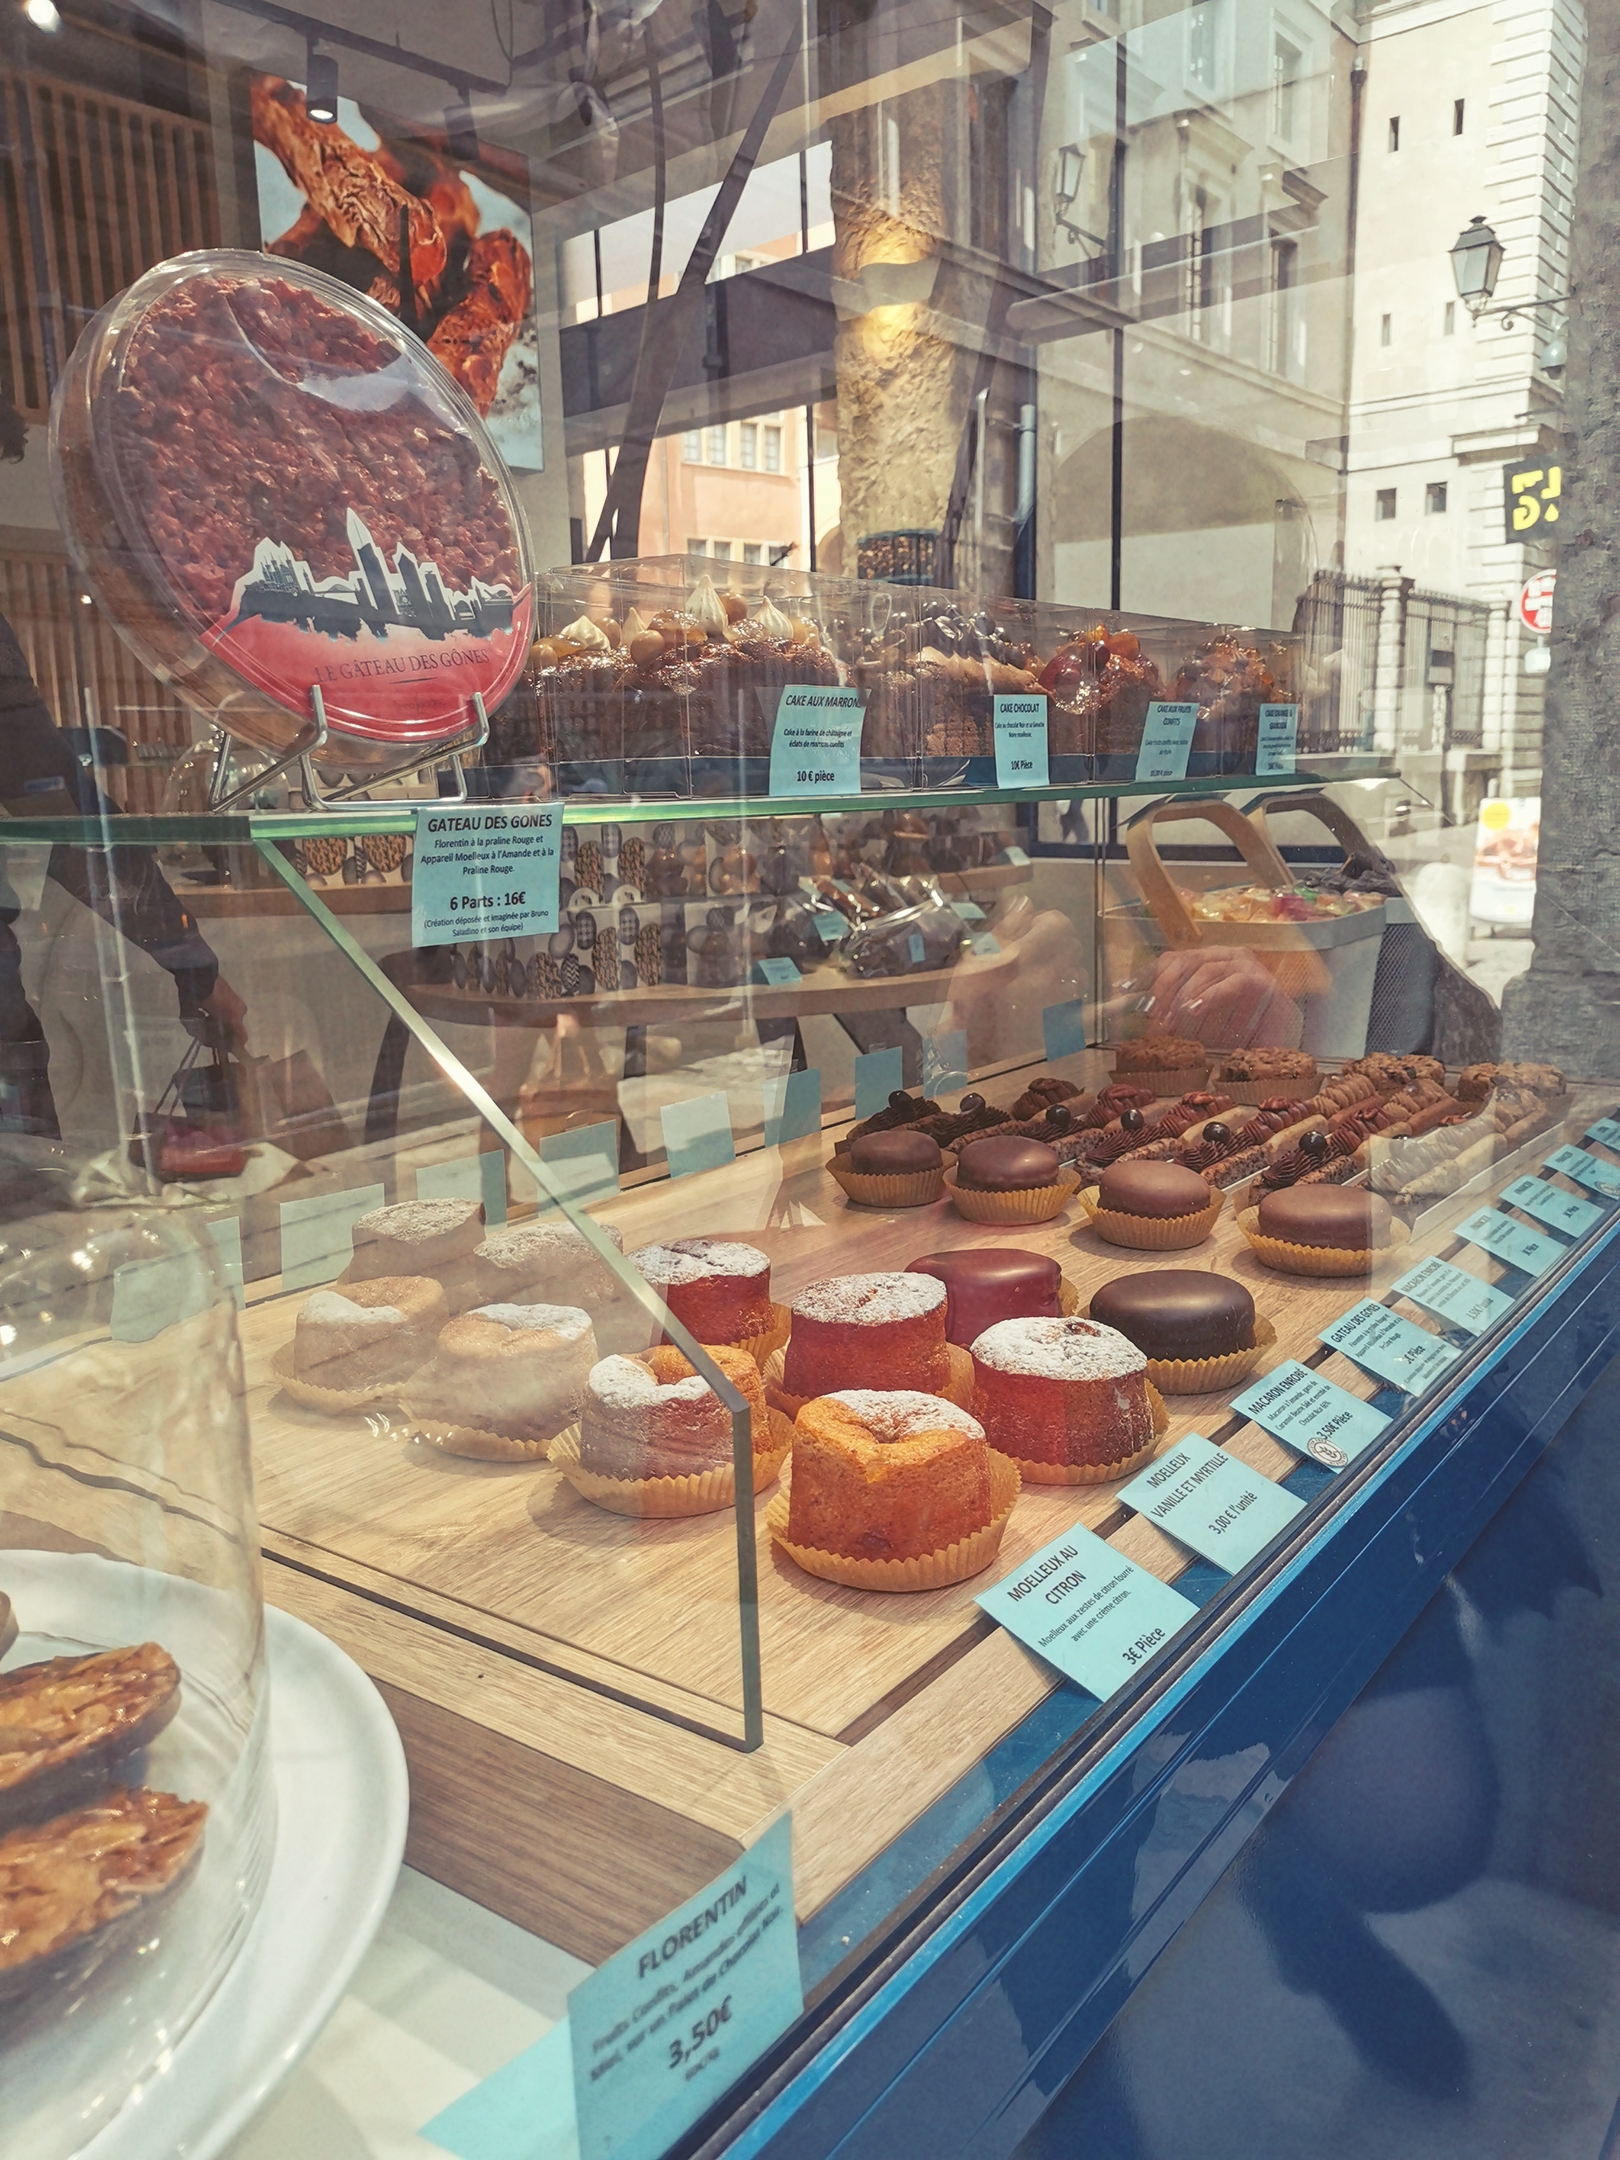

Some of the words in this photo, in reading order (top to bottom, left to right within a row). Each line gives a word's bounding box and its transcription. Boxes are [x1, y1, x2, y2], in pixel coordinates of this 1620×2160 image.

[315, 666, 338, 683] LE
[340, 657, 405, 679] GÂTEAU
[408, 653, 438, 671] DES
[440, 649, 490, 667] GÔNES
[786, 695, 807, 706] CAKE
[806, 695, 825, 707] AUX
[1000, 703, 1014, 713] CAKE
[1014, 703, 1040, 713] CHOCOLAT
[797, 770, 806, 781] 10
[808, 771, 813, 781] €
[814, 770, 834, 783] pièce
[428, 817, 481, 832] GATEAU
[485, 815, 508, 829] DES
[511, 814, 552, 828] GONES
[435, 839, 469, 848] Florentin
[471, 838, 475, 846] à
[477, 838, 484, 846] la
[485, 836, 510, 847] praline
[512, 835, 534, 845] Rouge
[535, 835, 543, 843] et
[420, 854, 453, 865] Appareil
[455, 851, 490, 861] Moelleux
[491, 851, 495, 859] à
[497, 849, 531, 859] l'Amande
[533, 848, 540, 856] et
[541, 847, 546, 856] à
[547, 847, 554, 856] la
[462, 865, 488, 875] Praline
[490, 865, 515, 874] Rouge.
[450, 896, 458, 910] 6
[462, 895, 493, 909] Parts
[504, 891, 526, 906] 16€
[424, 918, 454, 929] (Création
[455, 916, 482, 925] déposée
[483, 914, 490, 922] et
[490, 911, 518, 922] imaginée
[519, 911, 530, 919] par
[500, 922, 523, 932] équipe)
[1330, 1321, 1356, 1342] GATEAU
[1350, 1314, 1365, 1325] DES
[1407, 1345, 1425, 1358] Pièce
[1248, 1385, 1285, 1414] MACARON
[1278, 1367, 1307, 1389] ENROBÉ
[1267, 1404, 1286, 1420] Macaron
[1316, 1421, 1339, 1440] 3,50€
[1331, 1411, 1352, 1426] Pièce
[1146, 1452, 1191, 1488] MOELLEUX
[1150, 1489, 1185, 1518] VANILLE
[1182, 1480, 1196, 1493] ET
[1190, 1452, 1229, 1485] MYRTILLE
[1228, 1491, 1258, 1515] l'unité
[1208, 1515, 1232, 1535] 3,00
[1224, 1510, 1238, 1520] €
[1007, 1555, 1066, 1602] MOELLEUX
[1064, 1544, 1079, 1561] AU
[1045, 1570, 1087, 1605] CITRON
[1038, 1624, 1068, 1648] Moelleux
[1066, 1612, 1079, 1625] aux
[1076, 1597, 1096, 1615] zestes
[1093, 1590, 1104, 1601] de
[1101, 1579, 1119, 1596] citron
[1116, 1565, 1134, 1585] fourré
[1071, 1627, 1088, 1642] avec
[1085, 1616, 1099, 1630] une
[1096, 1601, 1116, 1621] crème
[1113, 1590, 1132, 1606] citron.
[1122, 1647, 1143, 1666] 3€
[1135, 1627, 1166, 1654] Pièce
[638, 1875, 747, 1979] FLORENTIN
[669, 1994, 732, 2069] 3,50€
